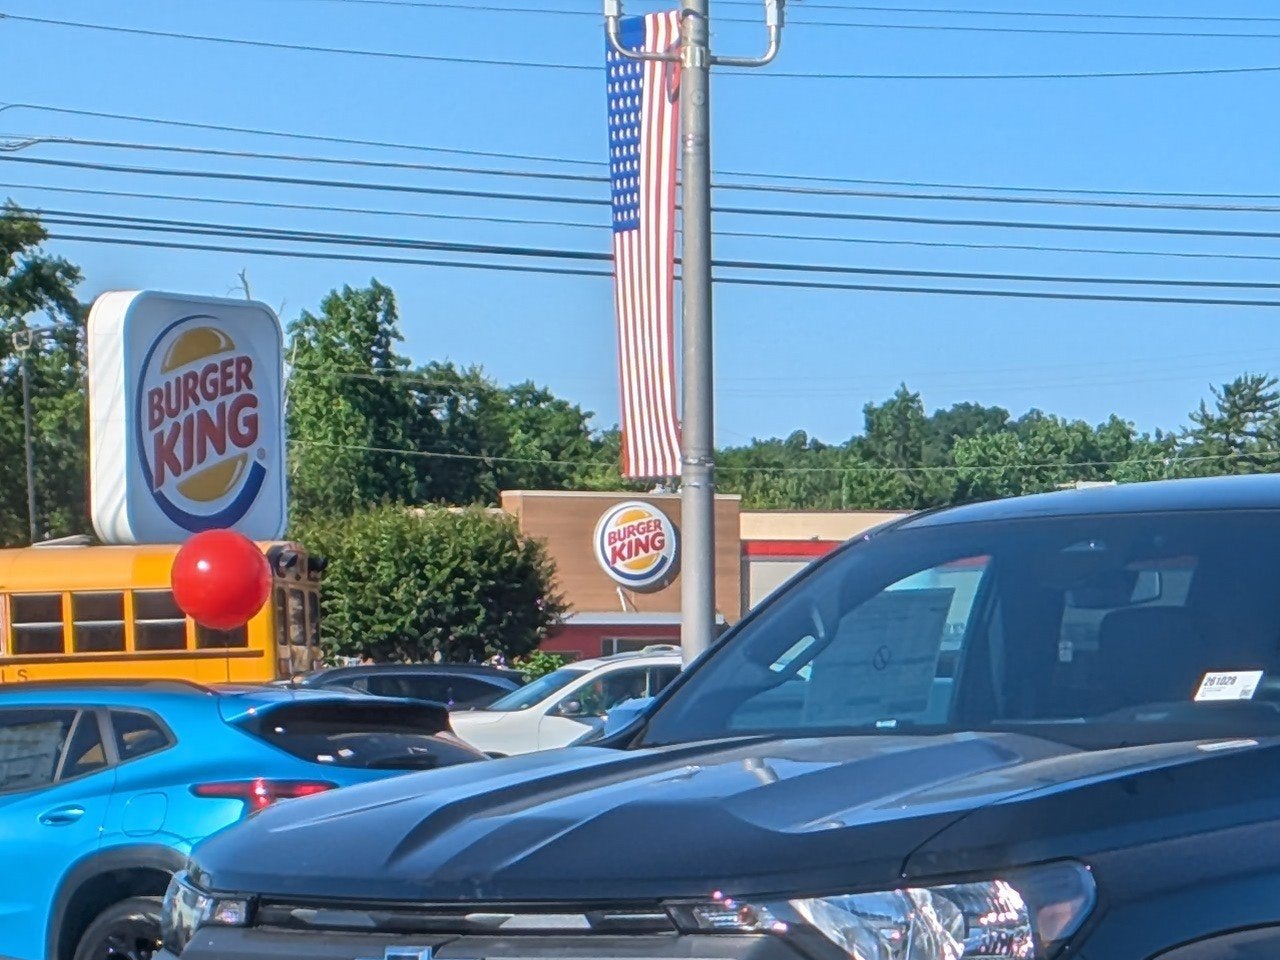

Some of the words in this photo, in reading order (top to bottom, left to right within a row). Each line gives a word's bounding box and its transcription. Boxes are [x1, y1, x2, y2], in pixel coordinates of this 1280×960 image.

[148, 355, 254, 432] BURGER
[153, 393, 259, 490] KING
[607, 518, 663, 546] BURGER
[610, 531, 665, 566] KING
